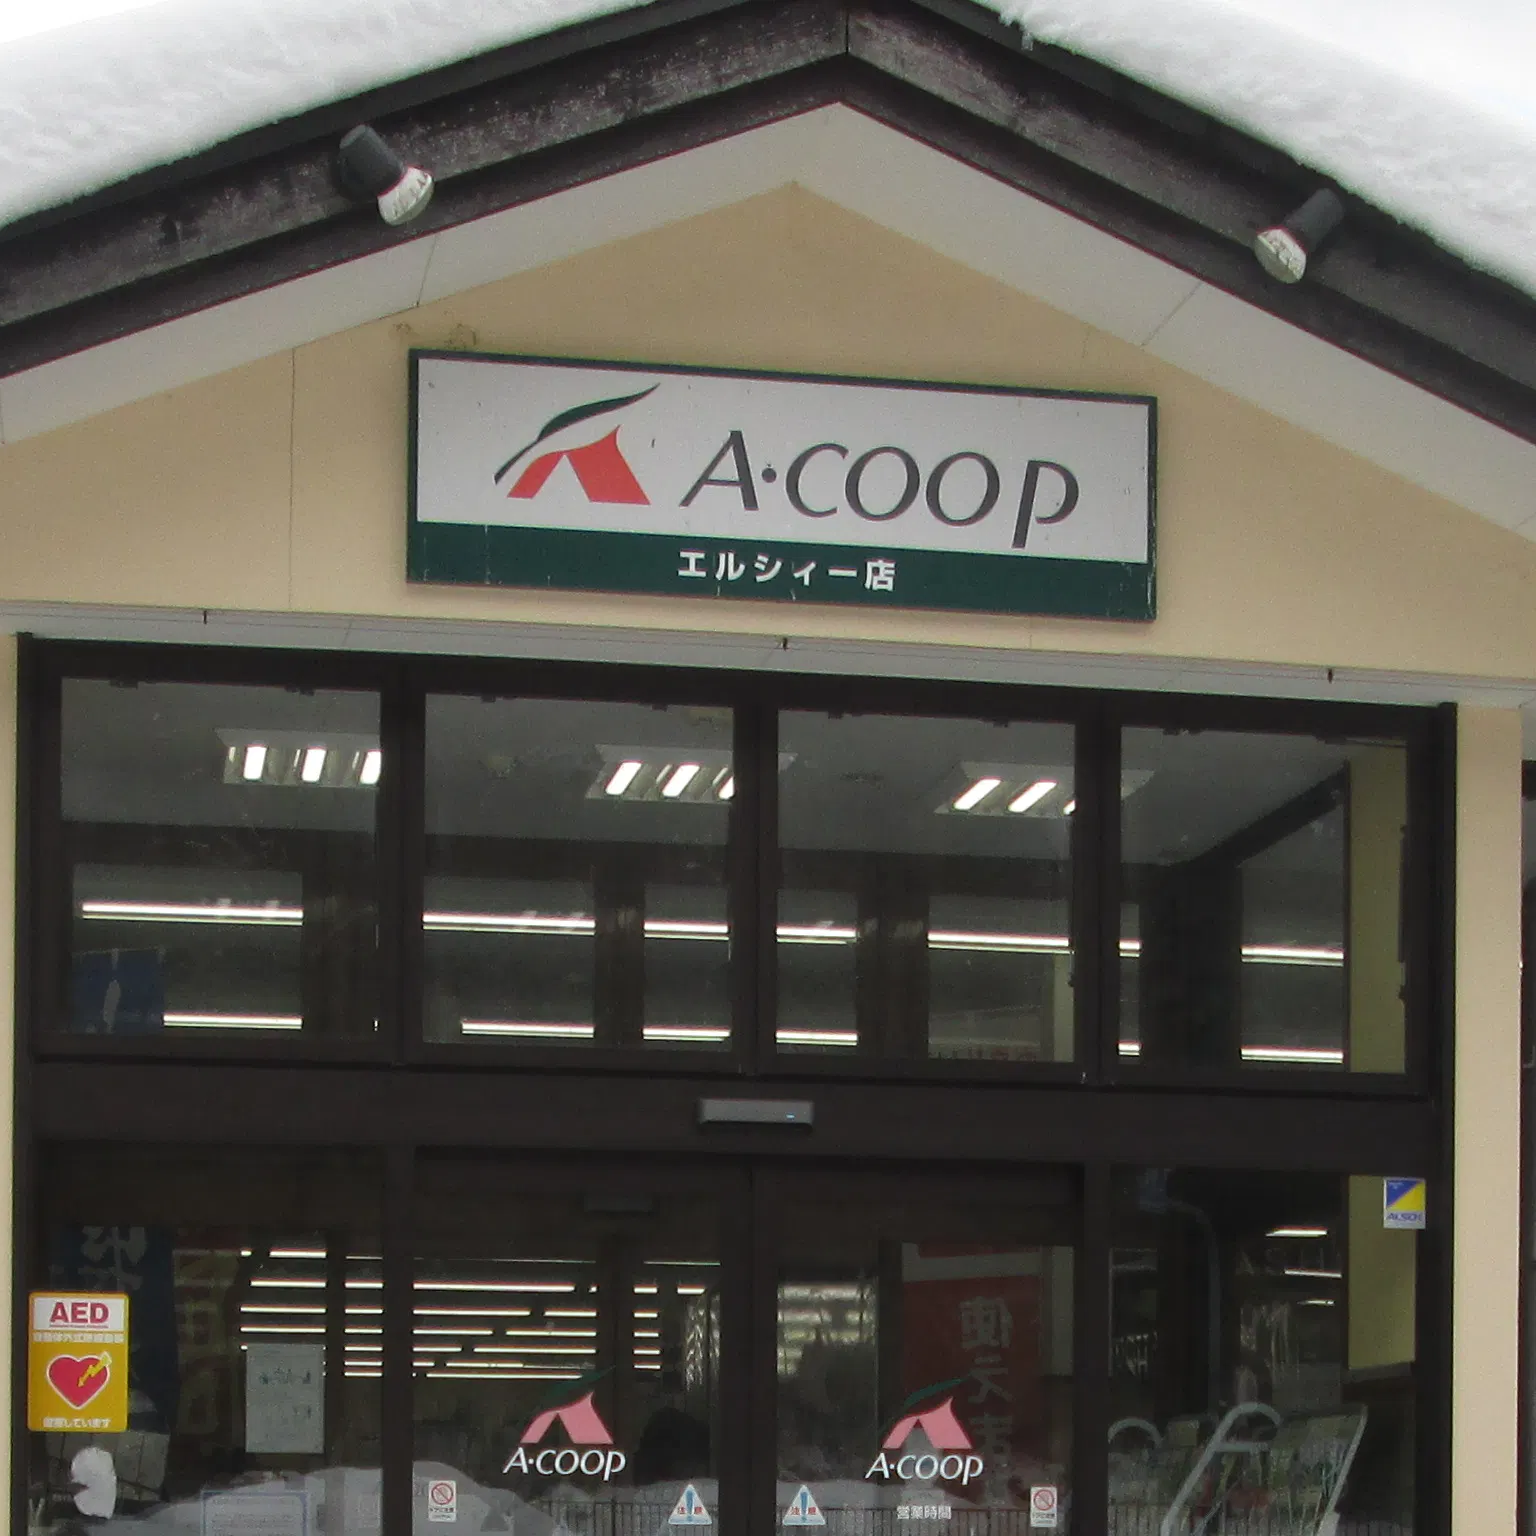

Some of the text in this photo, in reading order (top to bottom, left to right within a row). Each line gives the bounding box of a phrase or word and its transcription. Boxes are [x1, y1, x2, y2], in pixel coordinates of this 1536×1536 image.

[677, 550, 896, 592] エルシィー店
[49, 1302, 109, 1324] AED
[896, 1505, 953, 1520] 営業時間
